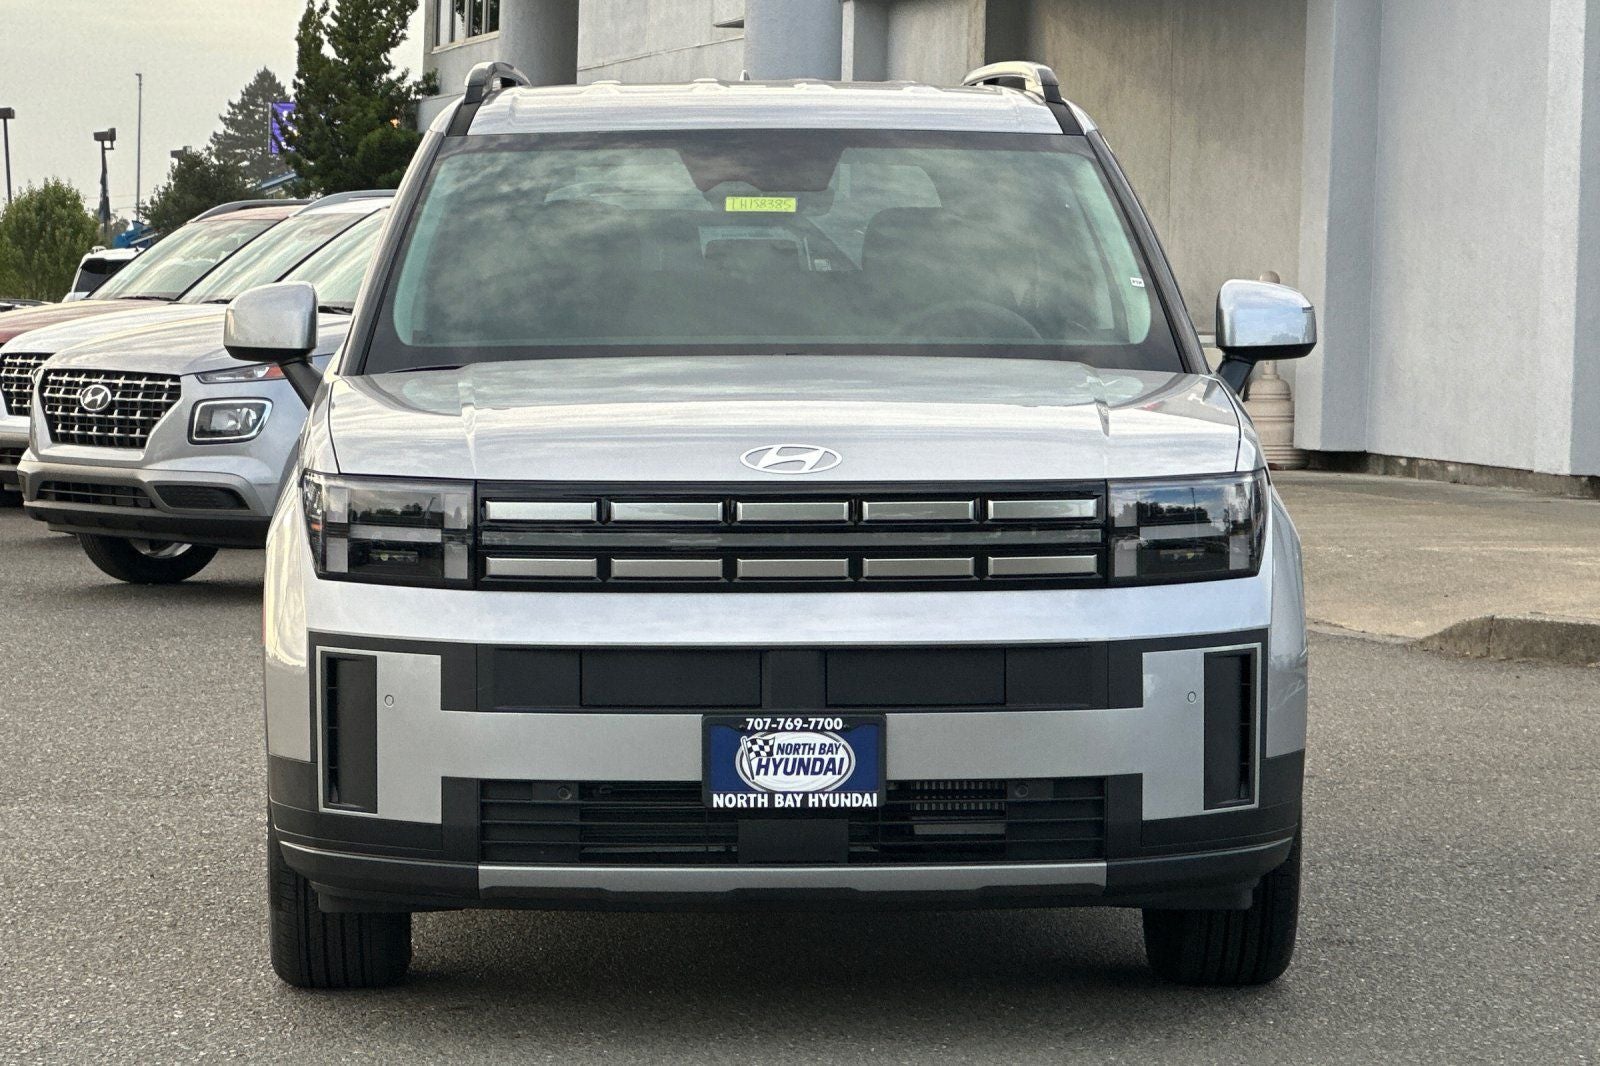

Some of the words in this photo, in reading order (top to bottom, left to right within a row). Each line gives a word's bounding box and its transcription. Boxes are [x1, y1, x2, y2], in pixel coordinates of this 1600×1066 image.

[746, 718, 843, 730] 707-769-7700
[776, 743, 815, 756] NORTH
[818, 743, 842, 755] BAY
[755, 757, 845, 776] HYUNDAI
[713, 793, 768, 808] NORTH
[775, 793, 803, 808] BAY
[808, 793, 877, 808] HYUNDAI
